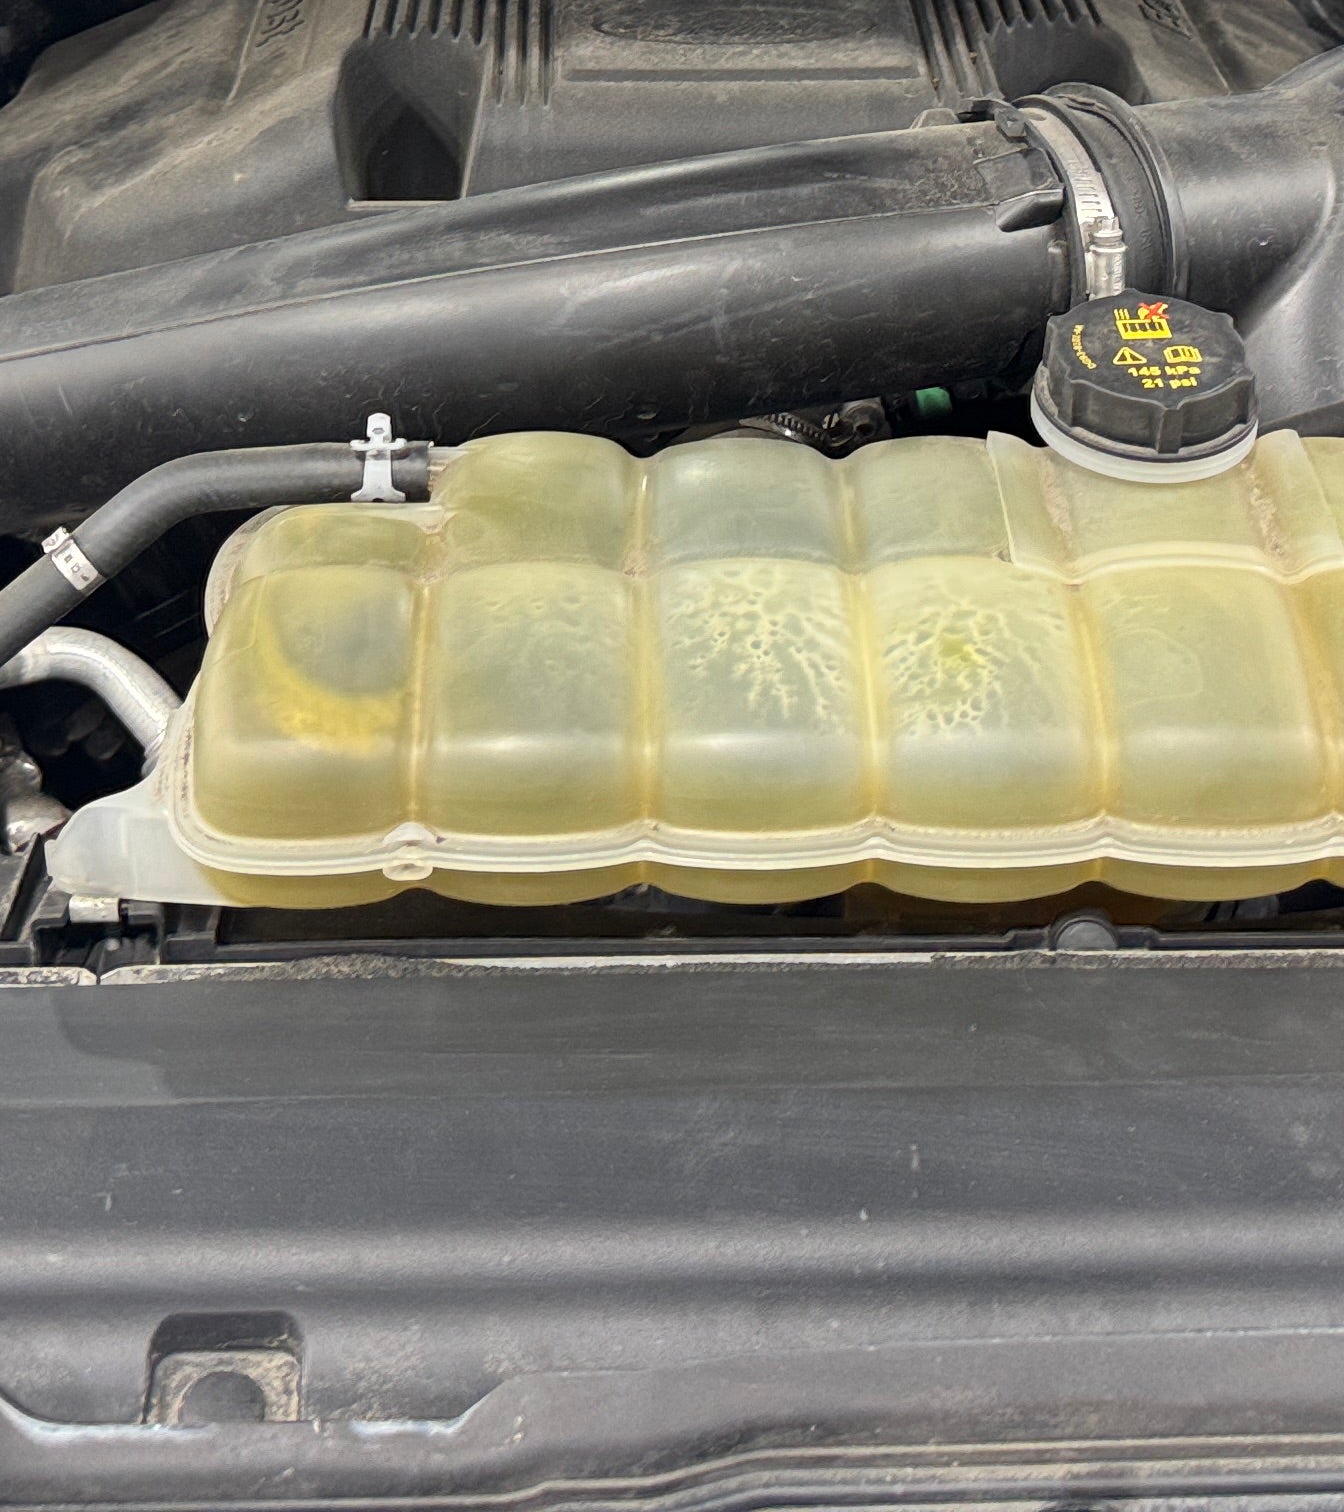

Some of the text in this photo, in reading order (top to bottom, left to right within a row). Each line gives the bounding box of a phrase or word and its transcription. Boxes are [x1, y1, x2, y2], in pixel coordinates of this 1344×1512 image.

[1128, 365, 1201, 377] 145 kPa
[1141, 376, 1197, 389] 21 psi
